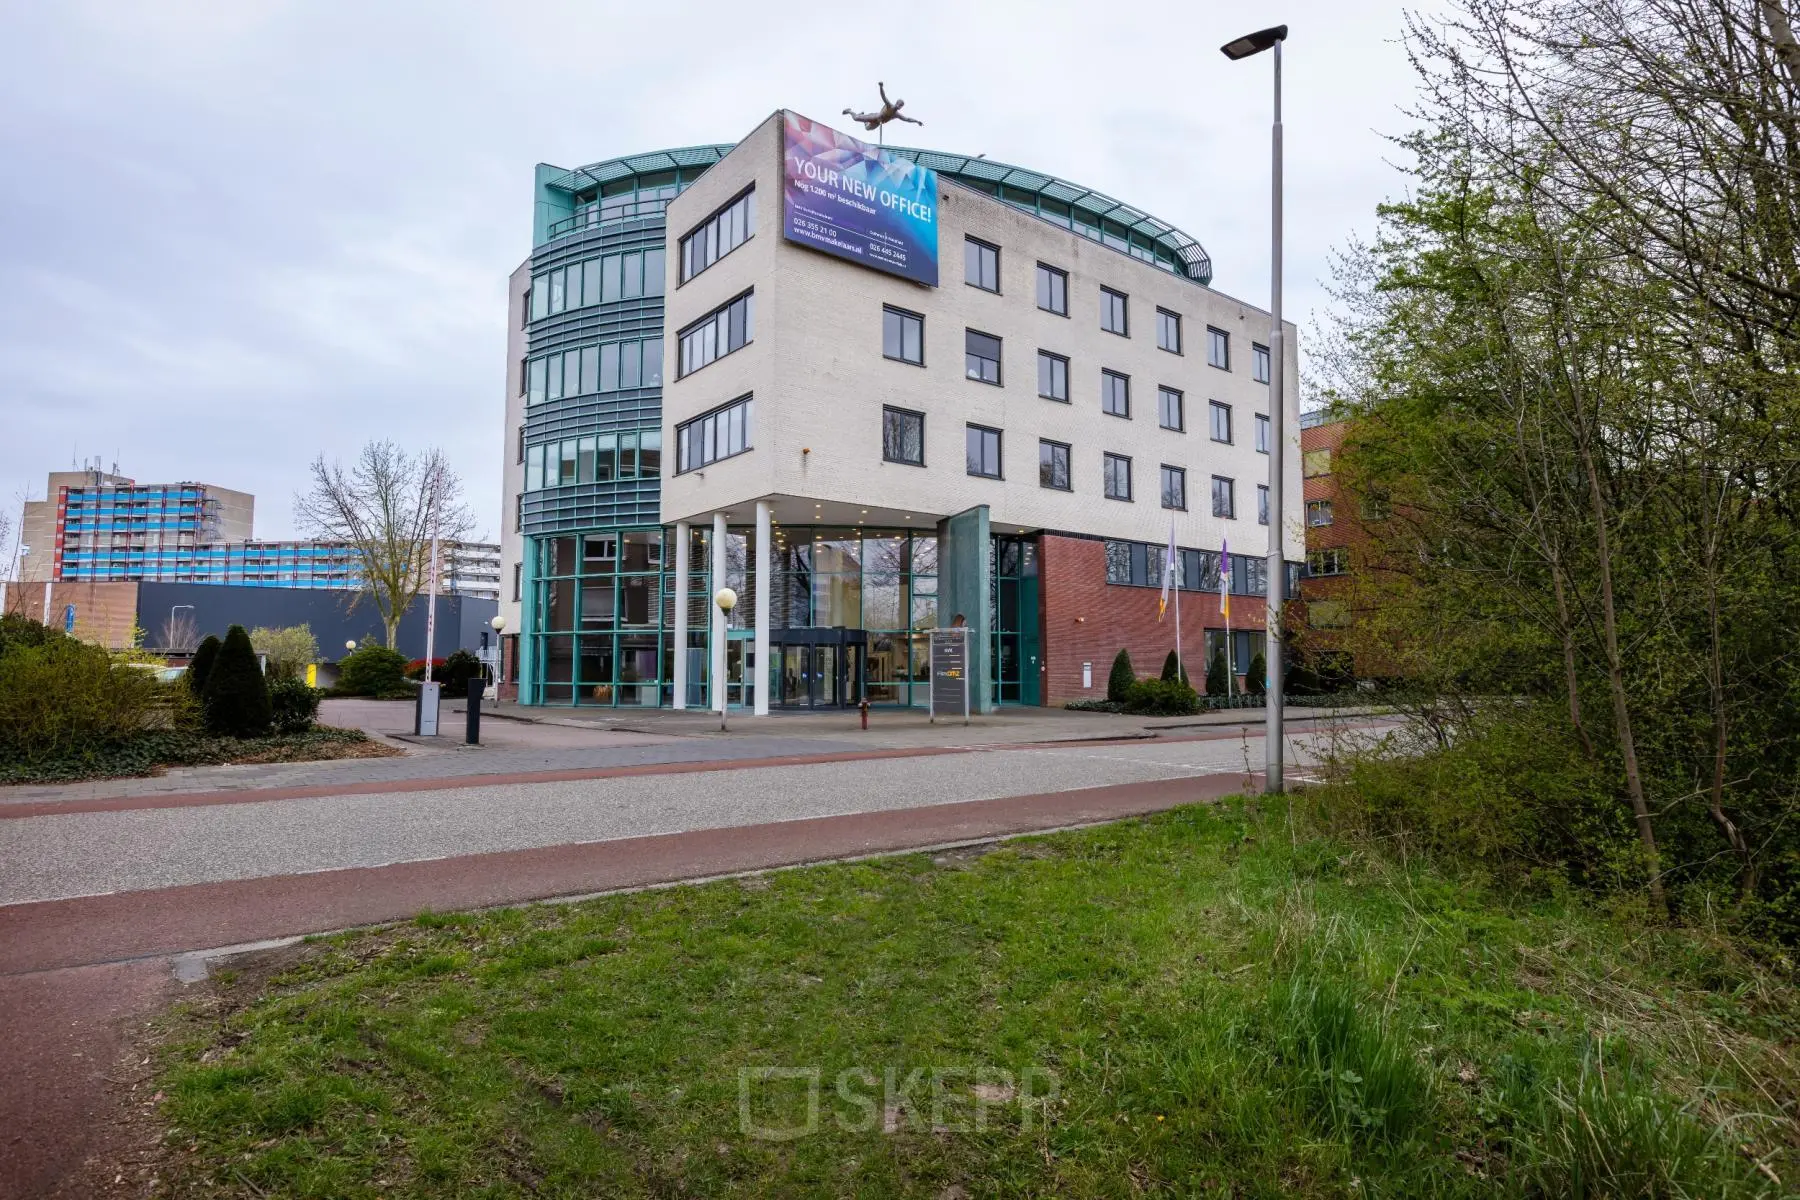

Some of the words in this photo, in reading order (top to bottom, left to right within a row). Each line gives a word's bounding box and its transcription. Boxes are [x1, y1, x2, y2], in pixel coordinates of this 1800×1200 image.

[794, 157, 839, 189] YOUR
[842, 175, 877, 202] NEW
[880, 190, 931, 223] OFFICE!
[794, 179, 809, 192] Nog
[837, 194, 877, 215] beschikbaar
[793, 217, 806, 227] 026
[807, 221, 819, 231] 355
[820, 226, 828, 235] 21
[828, 228, 837, 238] 00
[869, 242, 881, 252] 026
